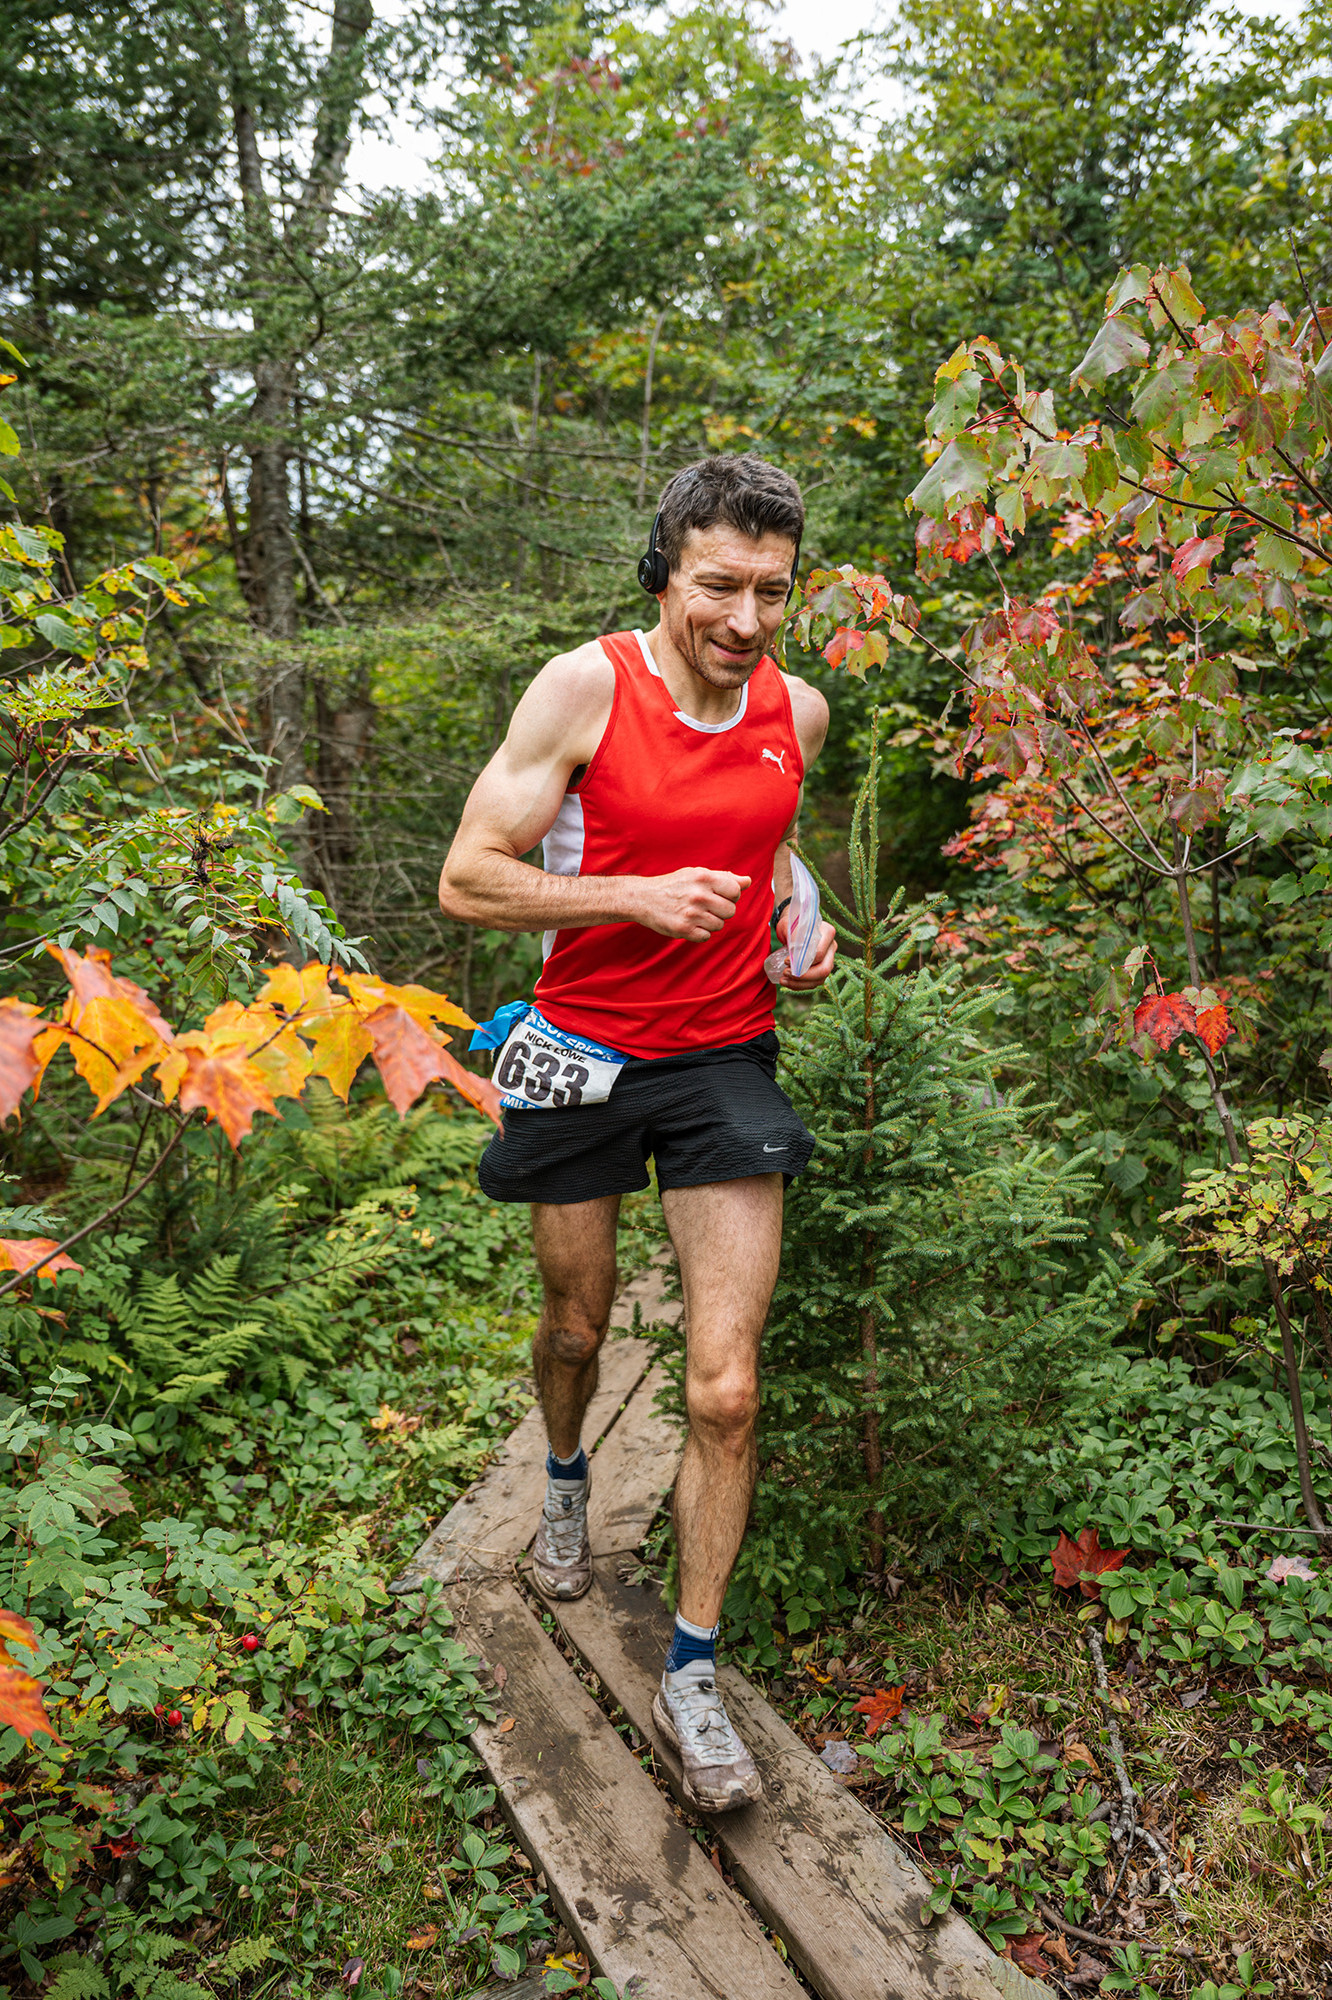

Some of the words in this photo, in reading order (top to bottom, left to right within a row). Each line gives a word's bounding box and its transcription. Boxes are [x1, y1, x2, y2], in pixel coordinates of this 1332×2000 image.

[525, 1031, 553, 1050] NICK
[553, 1047, 587, 1063] LOWE
[498, 1041, 589, 1108] 633
